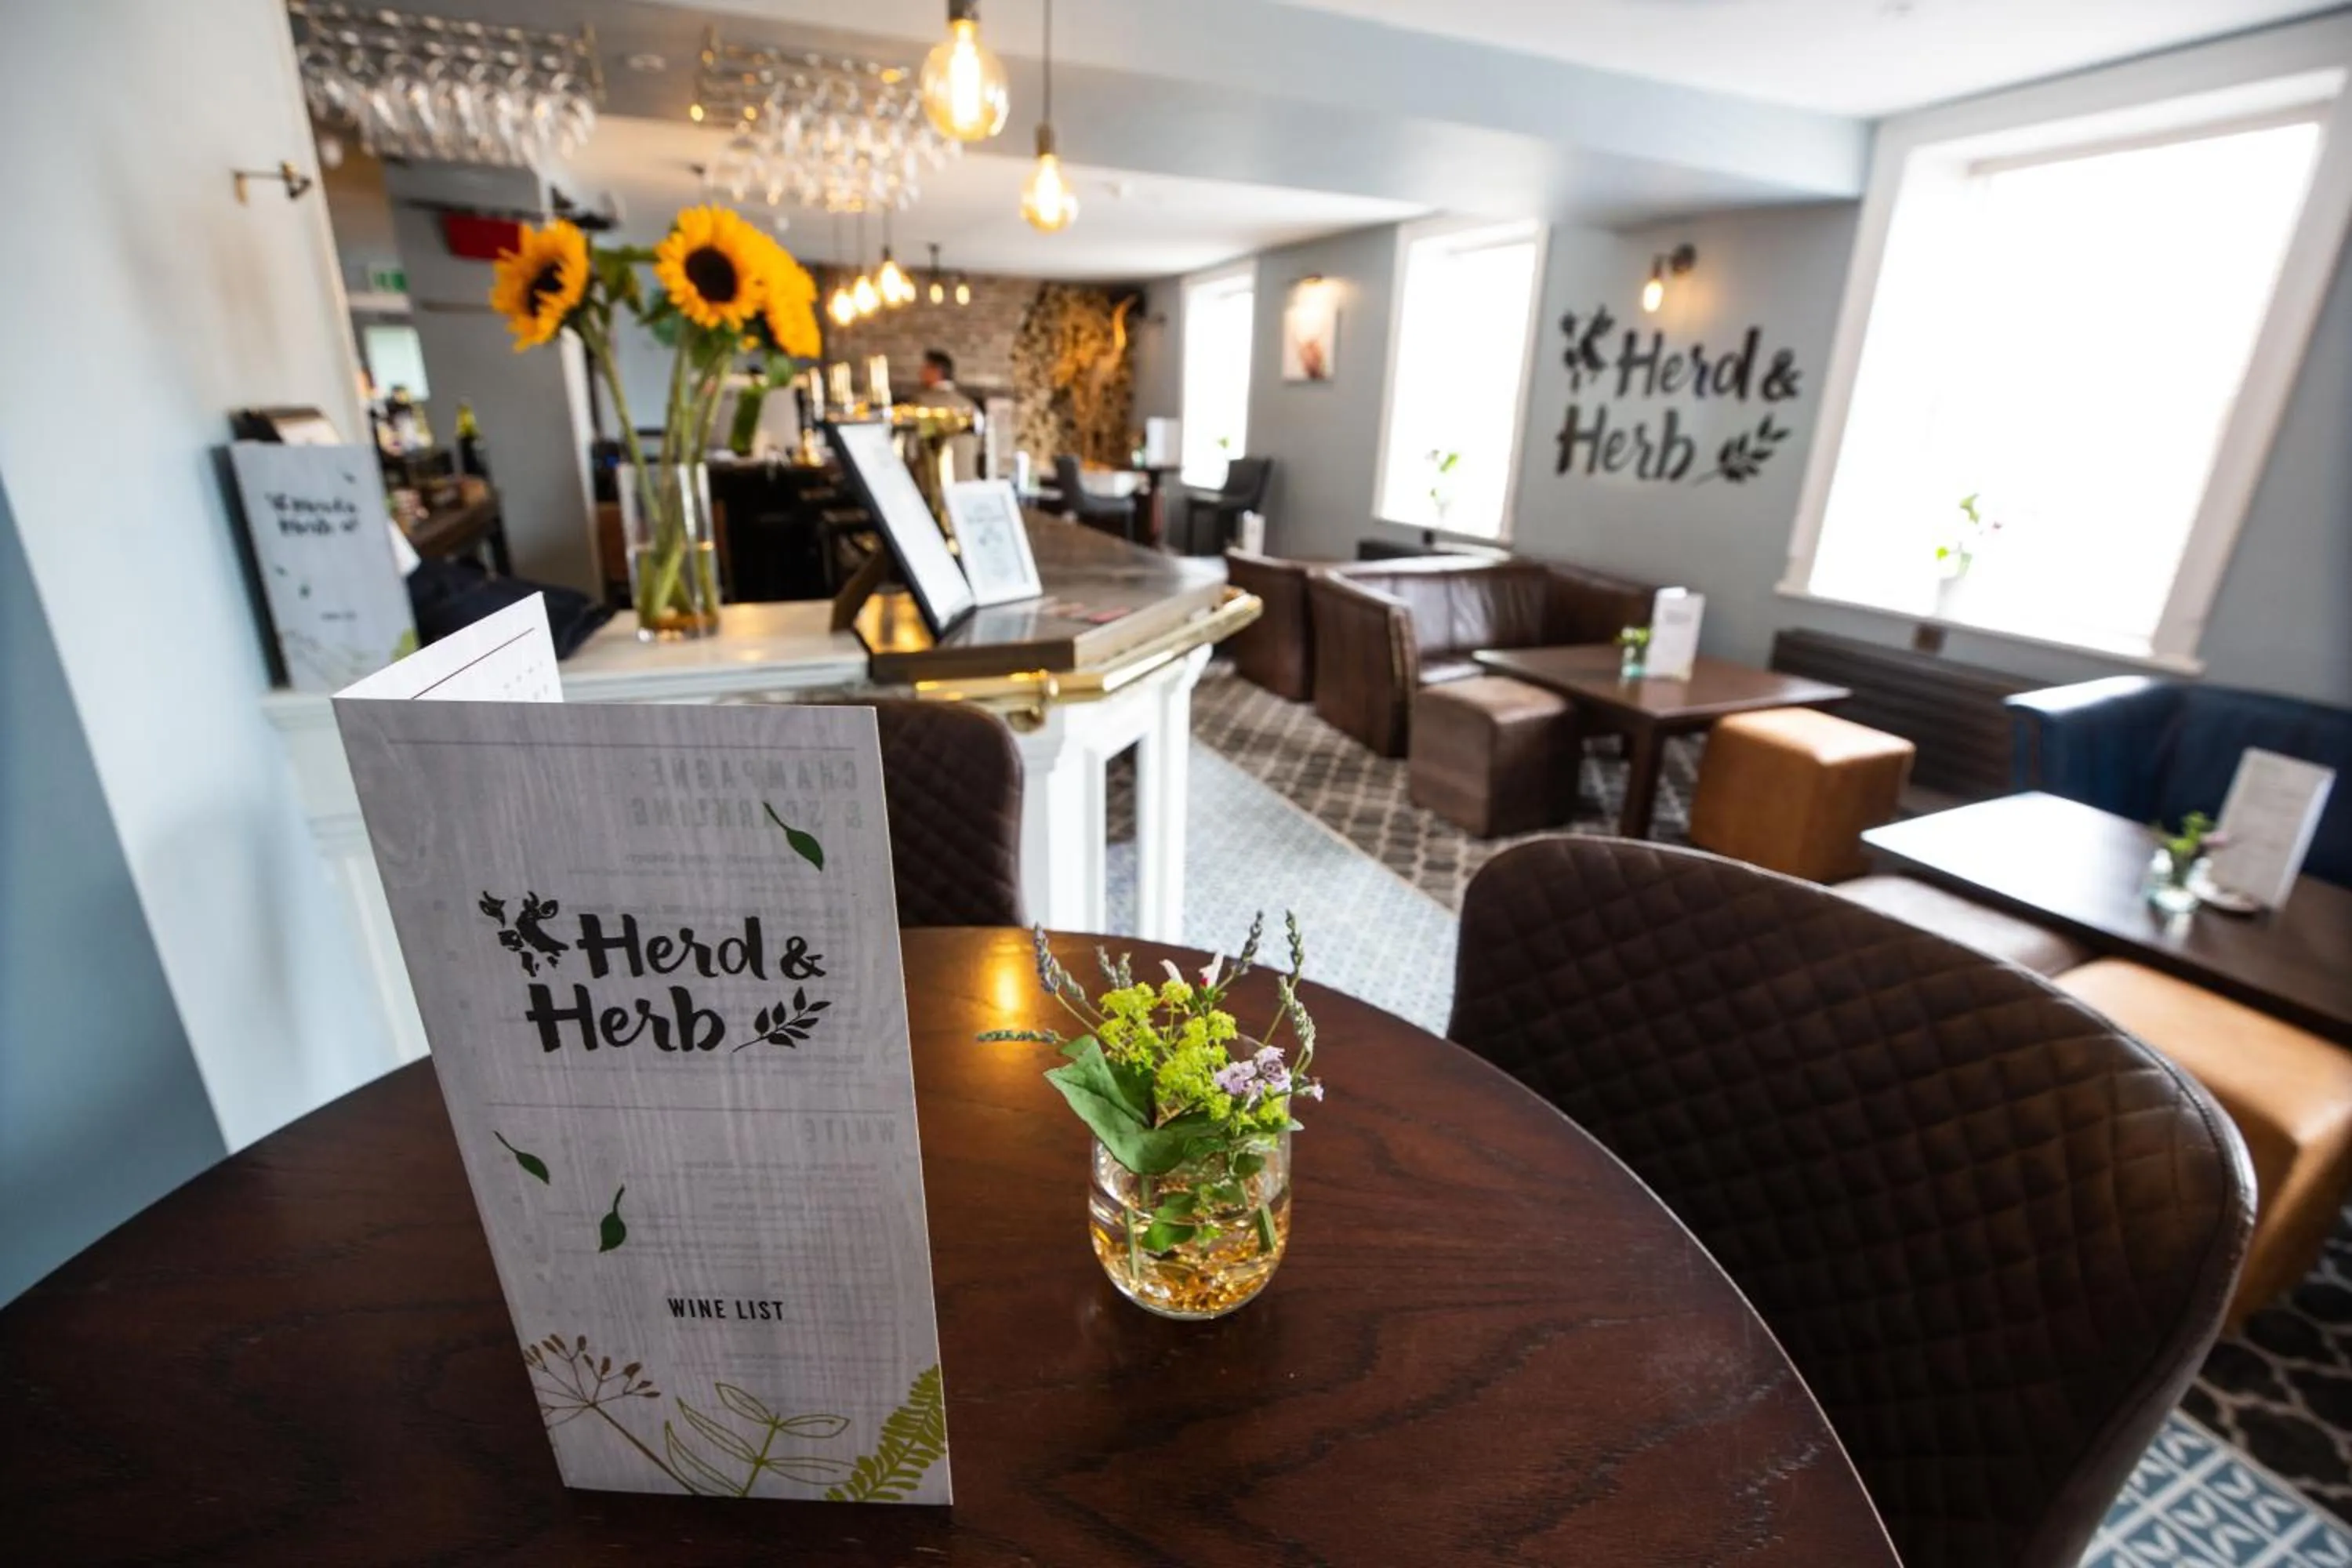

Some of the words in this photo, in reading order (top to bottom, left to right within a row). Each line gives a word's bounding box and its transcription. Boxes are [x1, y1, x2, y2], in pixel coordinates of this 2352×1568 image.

[1614, 325, 1762, 403] Herd
[1759, 348, 1802, 404] &
[1555, 403, 1697, 482] Herb
[575, 913, 768, 981] Herd
[779, 935, 827, 981] &
[524, 982, 726, 1053] Herb
[666, 1298, 727, 1319] WINE
[735, 1299, 784, 1322] LIST
